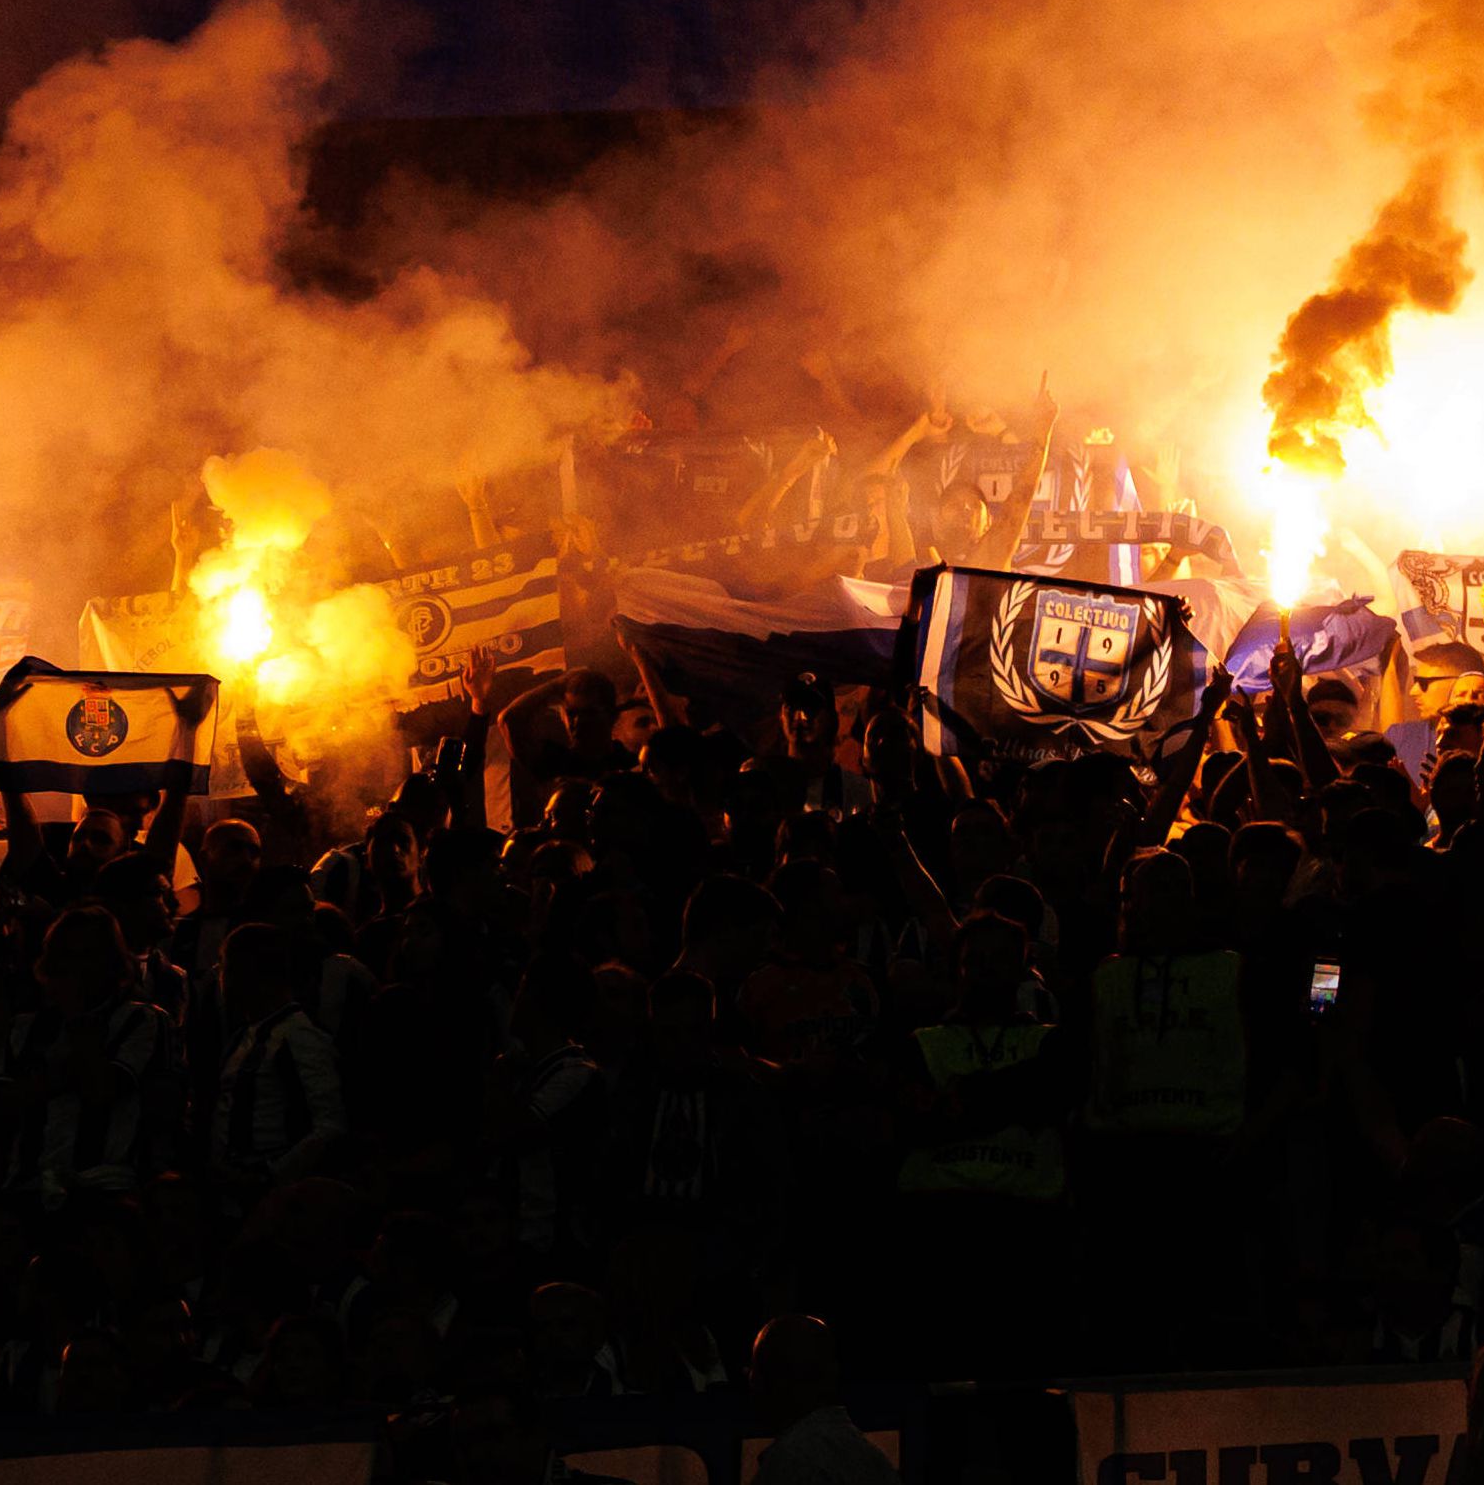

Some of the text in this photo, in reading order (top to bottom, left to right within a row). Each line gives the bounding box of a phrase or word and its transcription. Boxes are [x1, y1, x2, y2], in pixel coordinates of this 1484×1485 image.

[472, 552, 514, 581] 23
[1102, 637, 1113, 654] 9
[1049, 670, 1107, 694] 9 5
